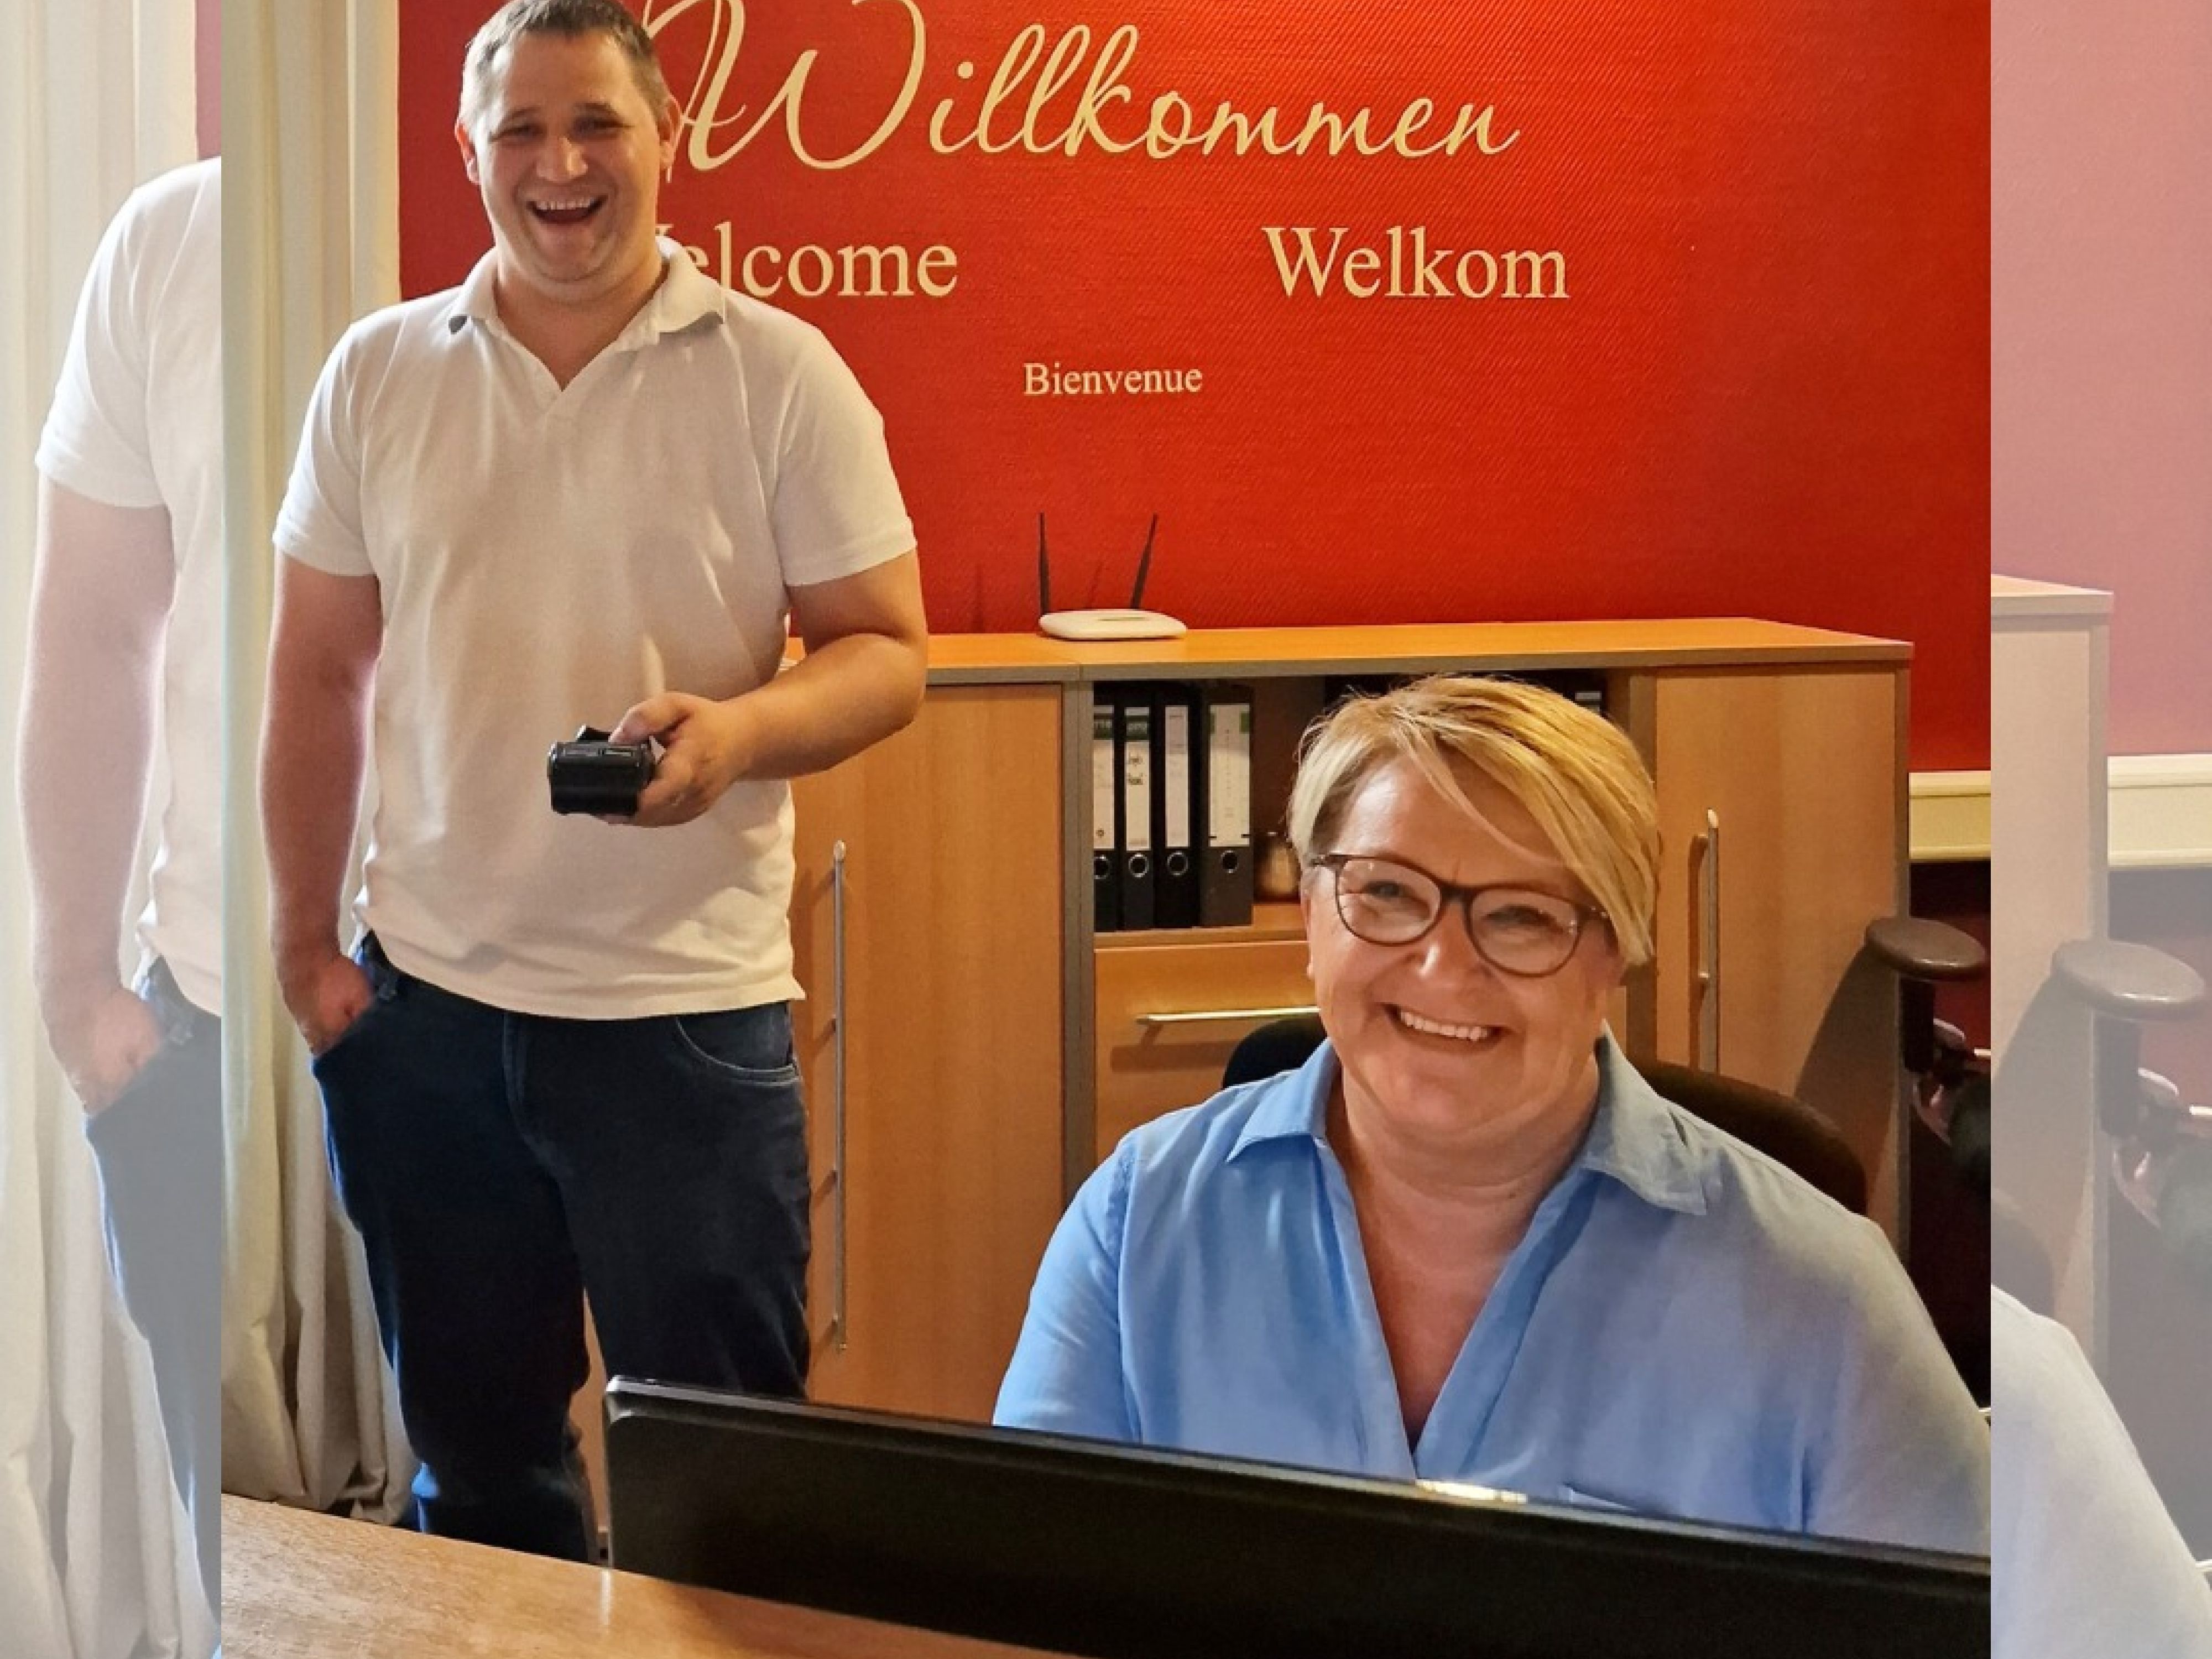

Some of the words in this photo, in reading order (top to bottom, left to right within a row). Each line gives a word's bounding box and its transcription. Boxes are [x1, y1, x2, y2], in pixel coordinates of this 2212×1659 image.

[643, 0, 1521, 183] Willkommen
[655, 221, 959, 298] lcome
[1261, 225, 1570, 299] Welkom
[1024, 362, 1203, 395] Bienvenue
